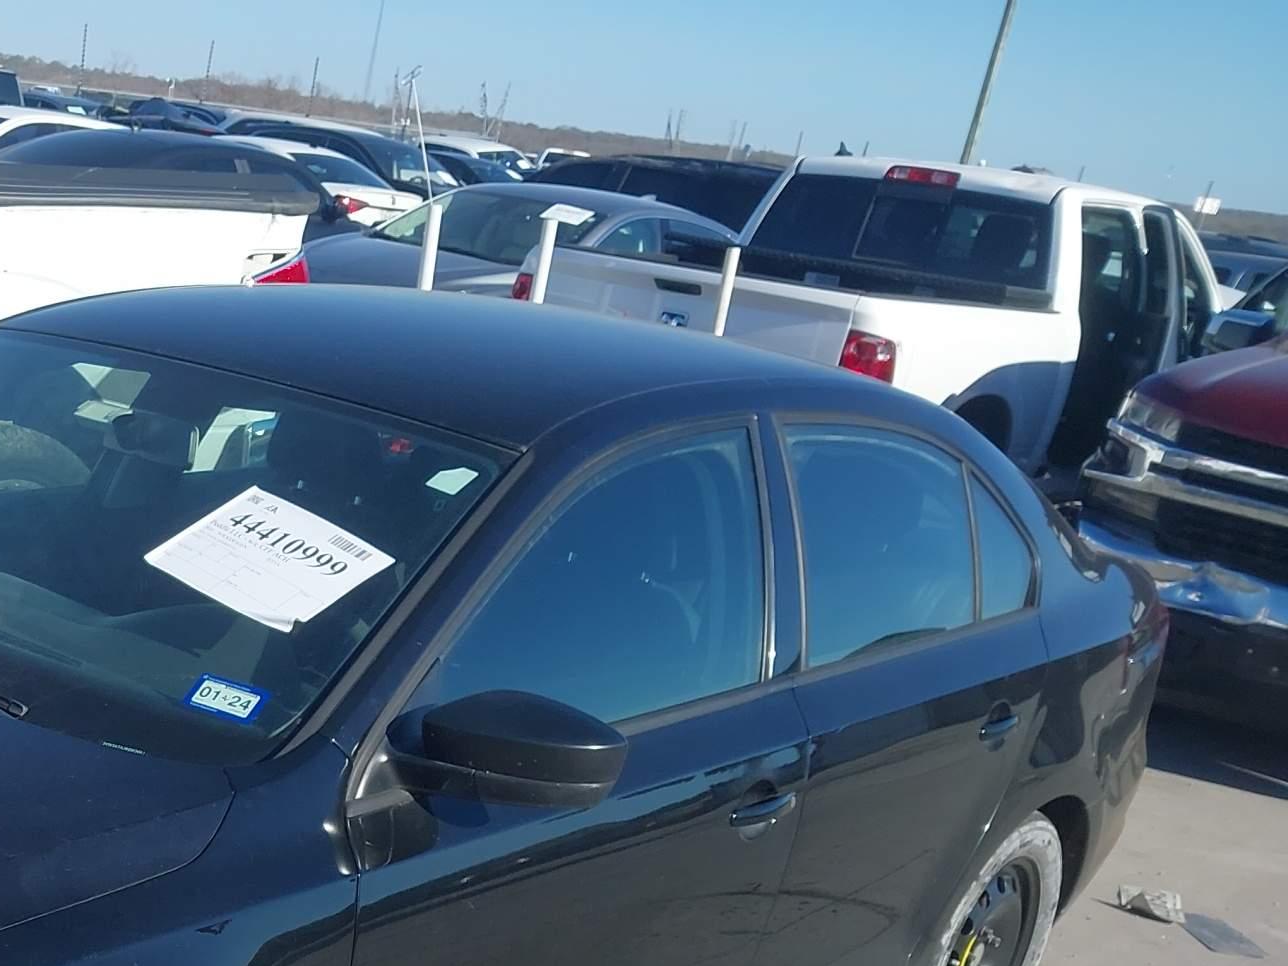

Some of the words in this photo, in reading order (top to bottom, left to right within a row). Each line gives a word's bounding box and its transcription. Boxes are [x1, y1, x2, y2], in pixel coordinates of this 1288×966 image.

[229, 513, 349, 576] 44410999
[199, 686, 221, 701] 01
[227, 695, 252, 711] 24
